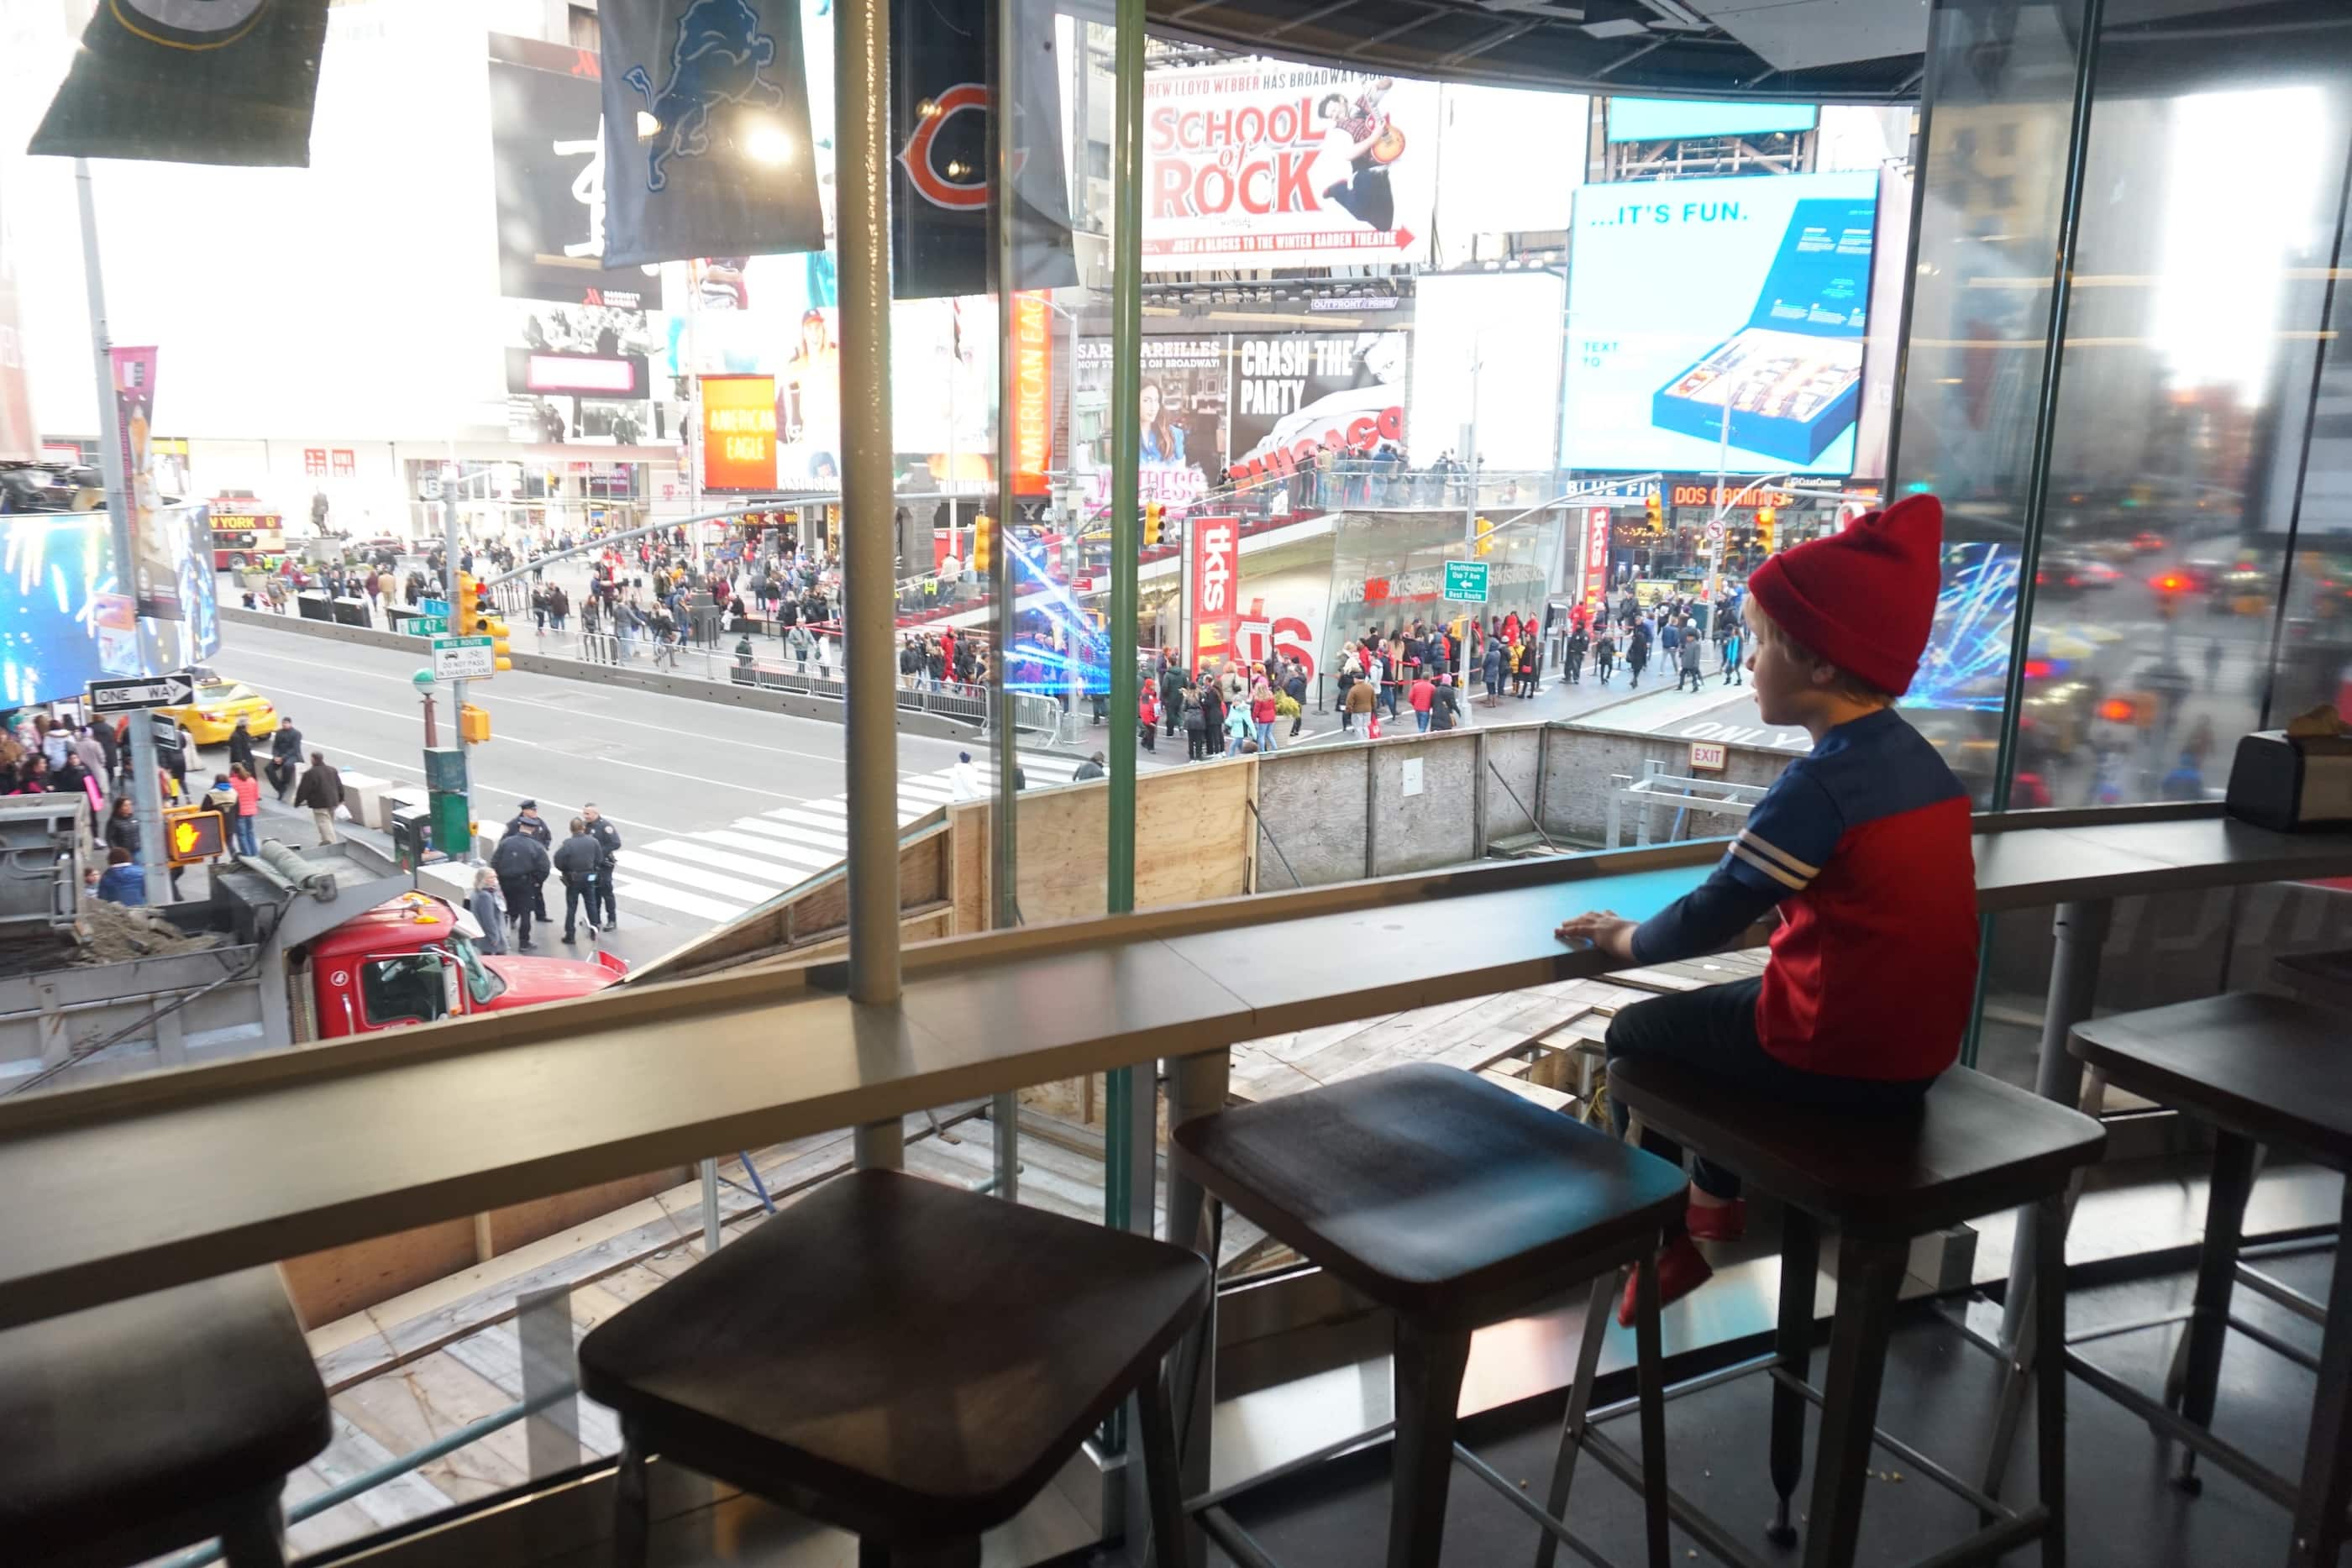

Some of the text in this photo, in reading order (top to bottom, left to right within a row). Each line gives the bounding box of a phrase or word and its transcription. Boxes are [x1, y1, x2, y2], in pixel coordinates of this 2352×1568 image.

[1175, 80, 1209, 96] LLOYD
[1214, 76, 1259, 93] WEBBER
[1263, 74, 1285, 90] HAS
[1290, 70, 1354, 87] BROADWAY
[1151, 97, 1326, 150] SCHOOL
[1219, 141, 1247, 174] of
[1152, 149, 1323, 218] ROCK
[1683, 202, 1749, 222] FUN.
[1205, 238, 1241, 251] BLOCKS
[1243, 237, 1254, 249] TO
[1257, 236, 1274, 249] THE
[1277, 234, 1312, 249] WINTER
[1315, 233, 1352, 248] GARDEN
[1355, 231, 1397, 246] THEATRE
[1020, 288, 1044, 343] EAG
[1077, 341, 1221, 359] SAR AREILLES
[1241, 339, 1355, 377] CRASH THE
[1240, 379, 1305, 415] PARTY
[725, 437, 766, 461] EAGLE
[1674, 486, 1708, 506] DOS
[220, 517, 256, 529] YORK
[1592, 509, 1606, 568] tkts
[1204, 525, 1232, 612] tkts
[409, 621, 420, 632] W
[424, 620, 437, 632] 47
[100, 684, 180, 703] ONE WAY
[1694, 747, 1721, 763] EXIT
